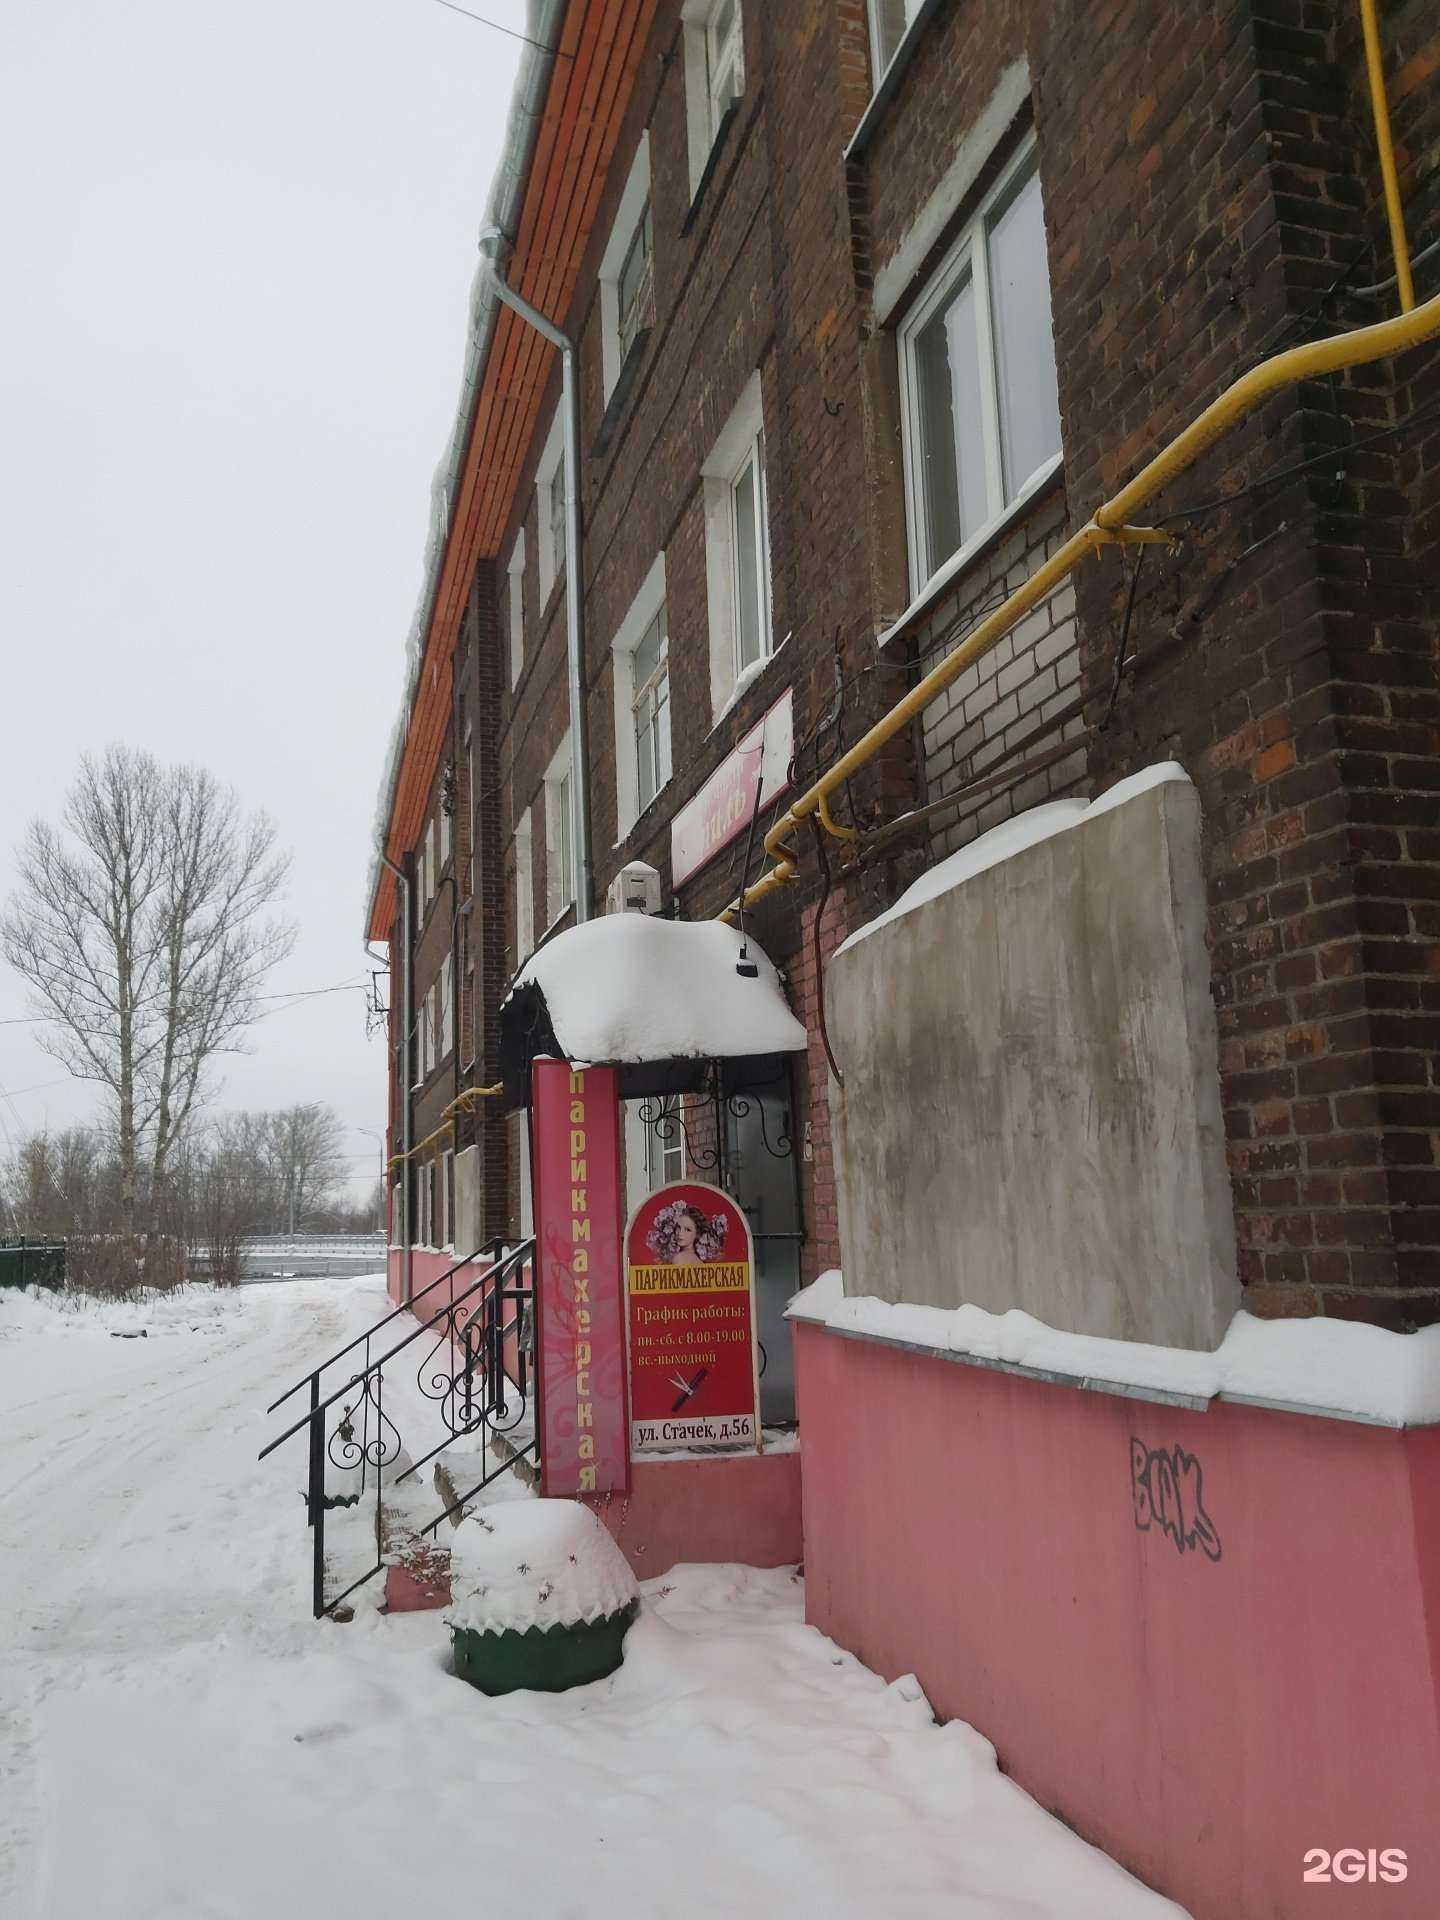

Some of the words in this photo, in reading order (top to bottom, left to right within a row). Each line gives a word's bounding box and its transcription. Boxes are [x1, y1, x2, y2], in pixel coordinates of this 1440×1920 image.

[569, 1070, 597, 1491] парикмахерская
[635, 1266, 745, 1291] ПАРИКМАХЕРСКАЯ
[637, 1305, 689, 1325] График
[692, 1304, 745, 1323] работы:
[686, 1329, 745, 1345] 8.00-19.00
[638, 1427, 659, 1446] ул.
[662, 1422, 717, 1440] Стачек,
[720, 1417, 750, 1440] д.56
